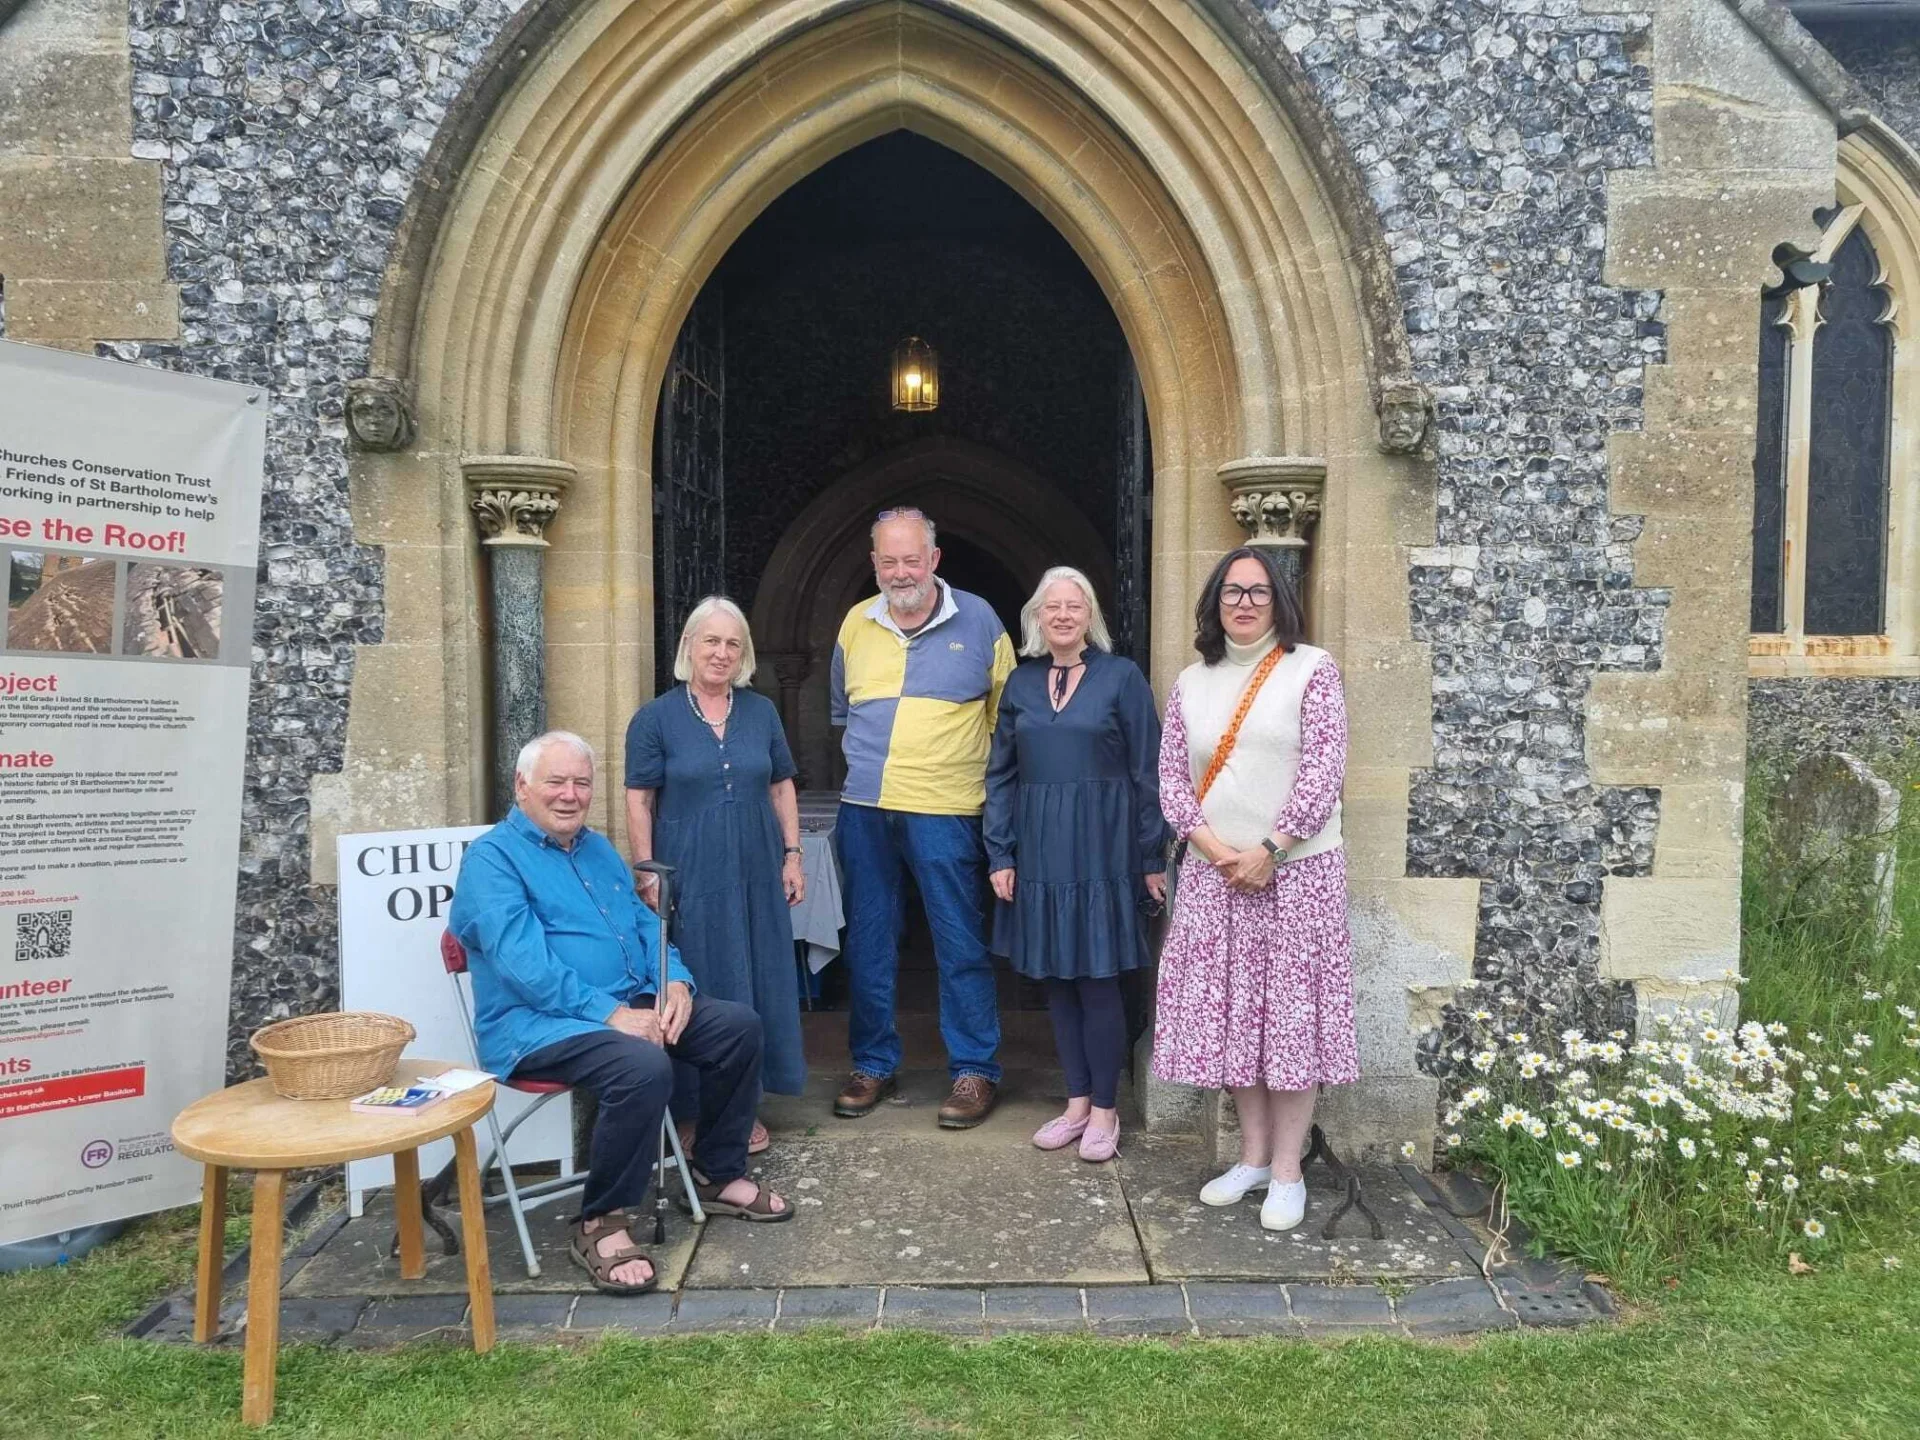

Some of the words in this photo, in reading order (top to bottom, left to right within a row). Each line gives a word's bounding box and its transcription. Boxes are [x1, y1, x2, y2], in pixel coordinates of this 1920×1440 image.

[0, 449, 67, 469] hurches
[72, 460, 171, 483] Conservation
[175, 473, 211, 488] Trust
[6, 467, 66, 486] Friends
[70, 477, 86, 489] of
[89, 479, 106, 491] St
[110, 483, 219, 505] Bartholomew's
[58, 492, 72, 504] in
[76, 496, 162, 516] partnership
[166, 505, 181, 517] to
[185, 507, 215, 522] help
[42, 518, 94, 544] the
[104, 524, 186, 554] Roof!
[357, 840, 473, 877] CHU
[387, 884, 455, 921] OP
[87, 1148, 108, 1161] FR
